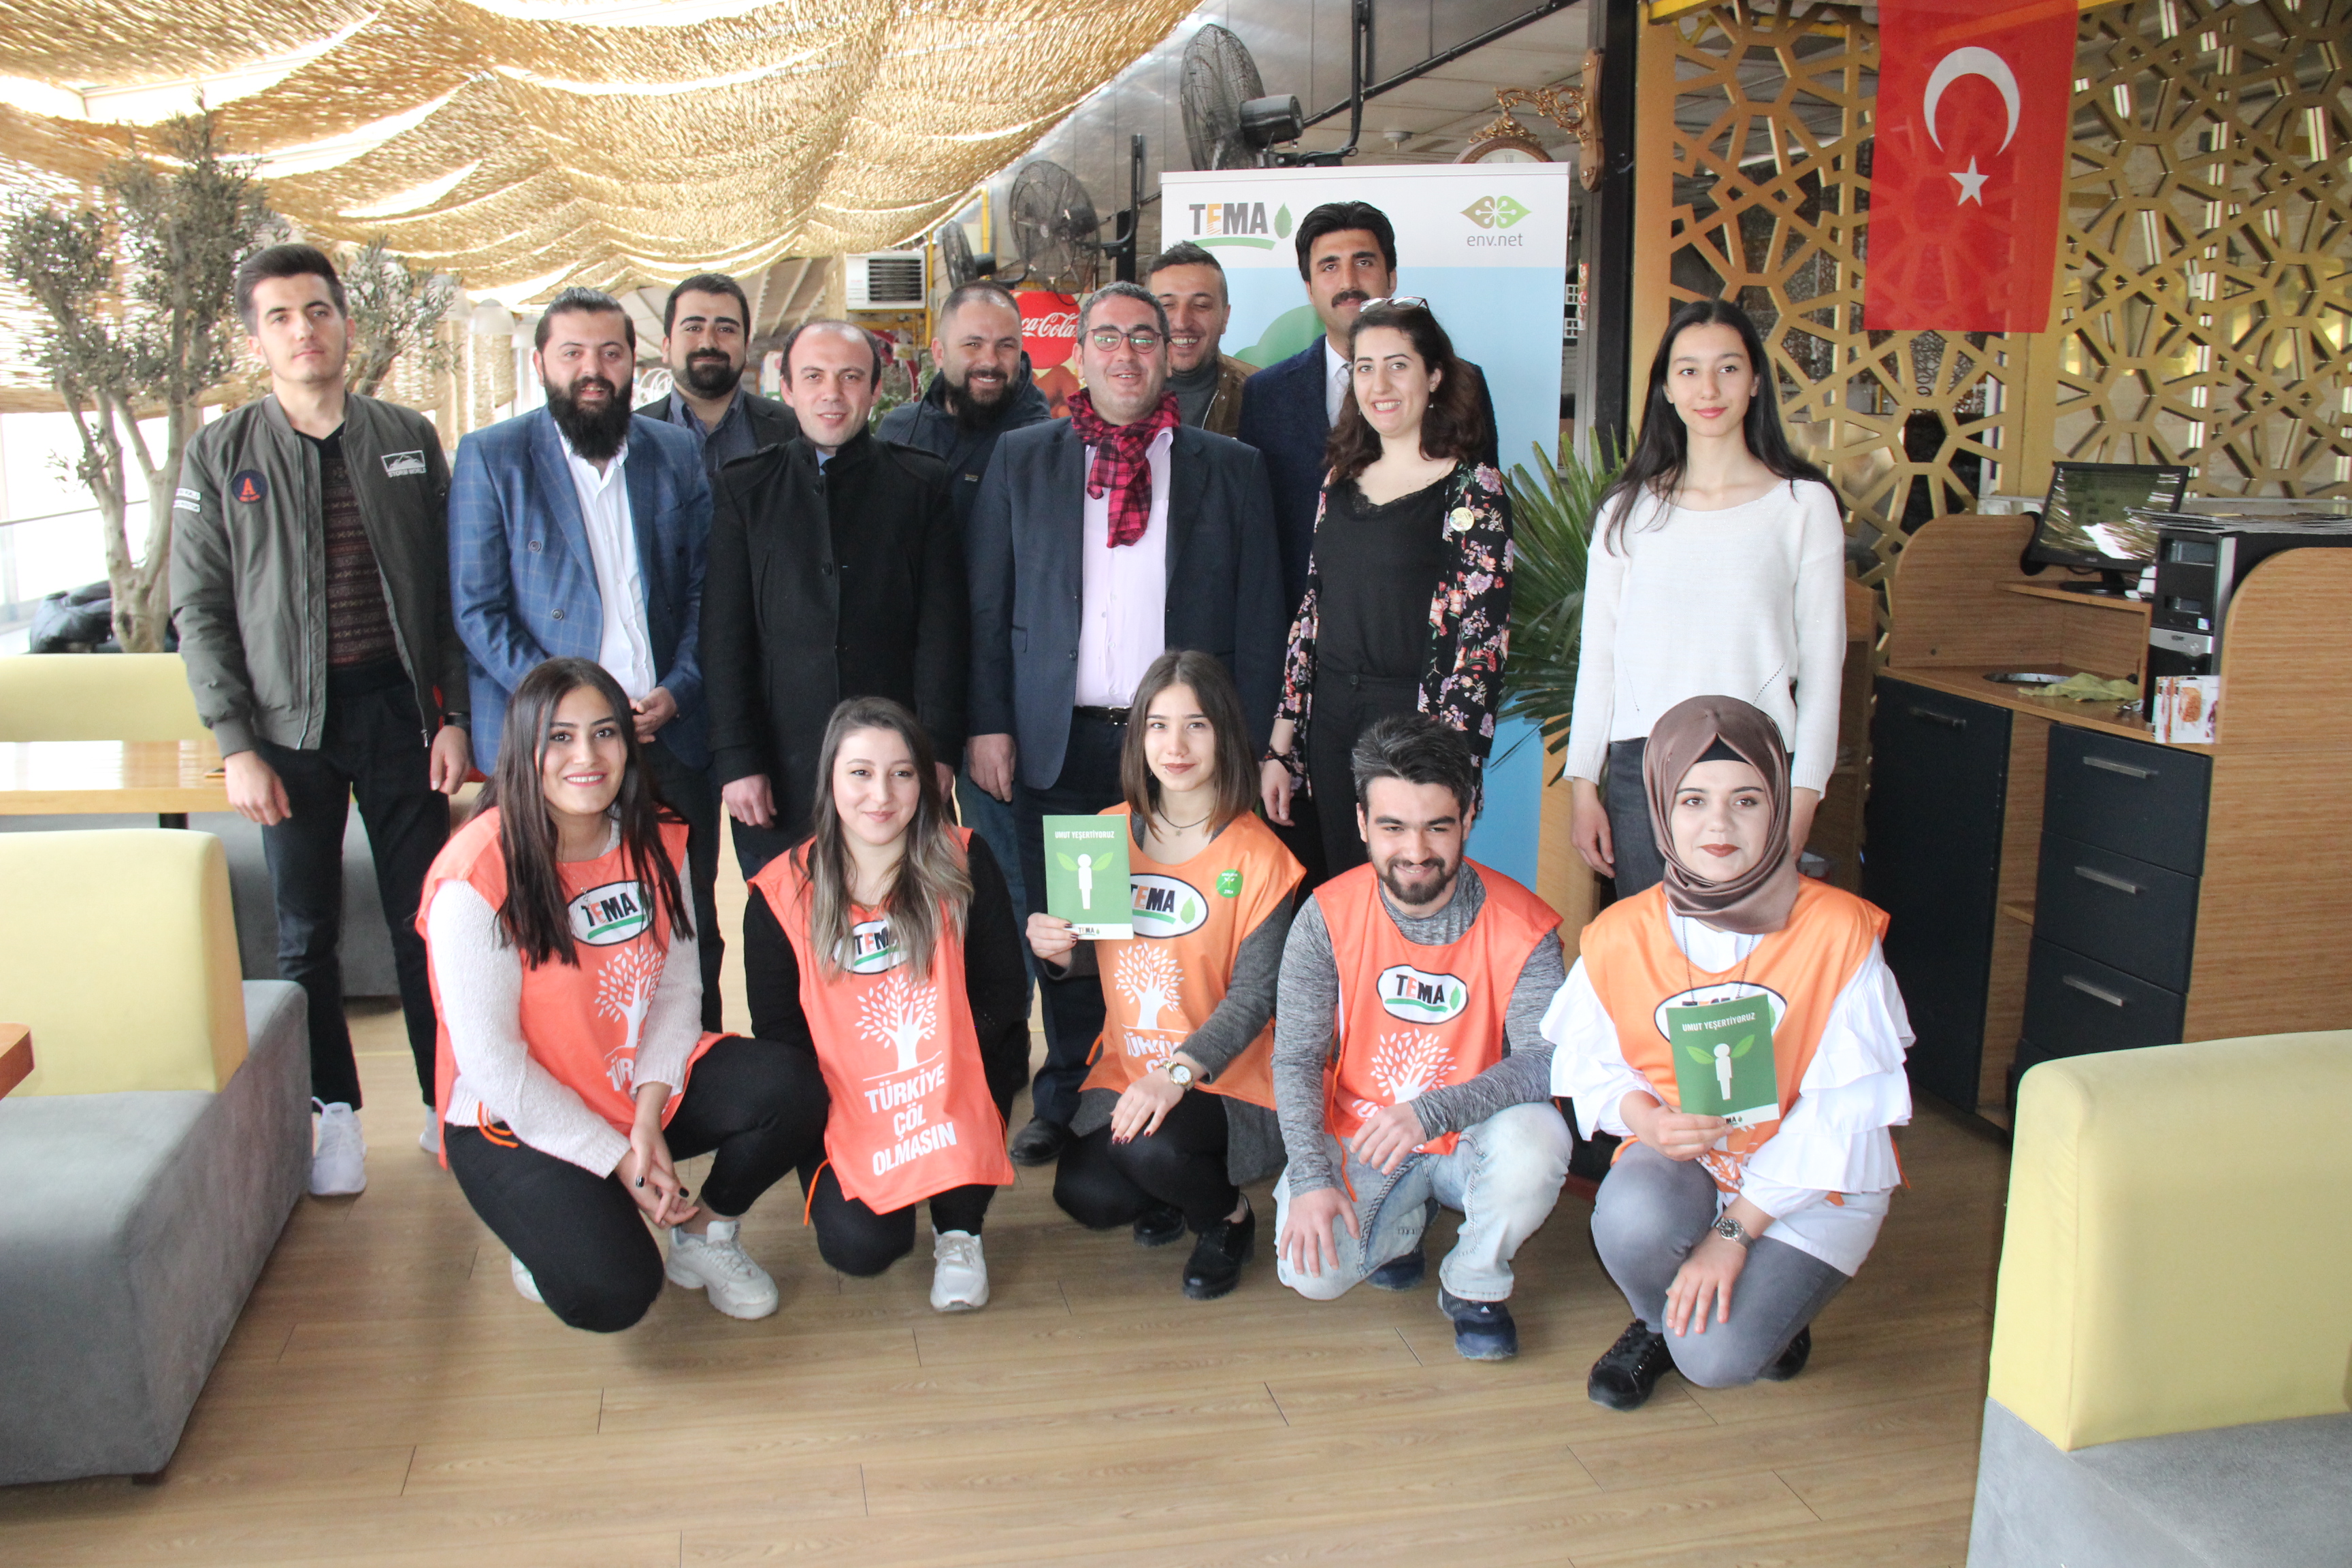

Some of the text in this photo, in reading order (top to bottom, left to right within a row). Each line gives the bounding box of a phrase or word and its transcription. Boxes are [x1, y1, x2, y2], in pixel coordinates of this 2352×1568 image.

[1189, 202, 1269, 235] TEMA
[1467, 233, 1523, 246] env.net
[1022, 312, 1079, 338] ca-Cola
[1055, 830, 1115, 840] UMUT YEŞERTİYORUZ
[581, 892, 638, 926] TEMA
[854, 926, 889, 955] TEM
[1396, 974, 1445, 1004] TEMA
[1682, 1012, 1756, 1032] UMUT YEŞERTİYORUZ
[864, 1062, 945, 1113] TÜRKİYE
[894, 1102, 926, 1141] ÇÖL
[872, 1122, 957, 1176] OLMASIN
